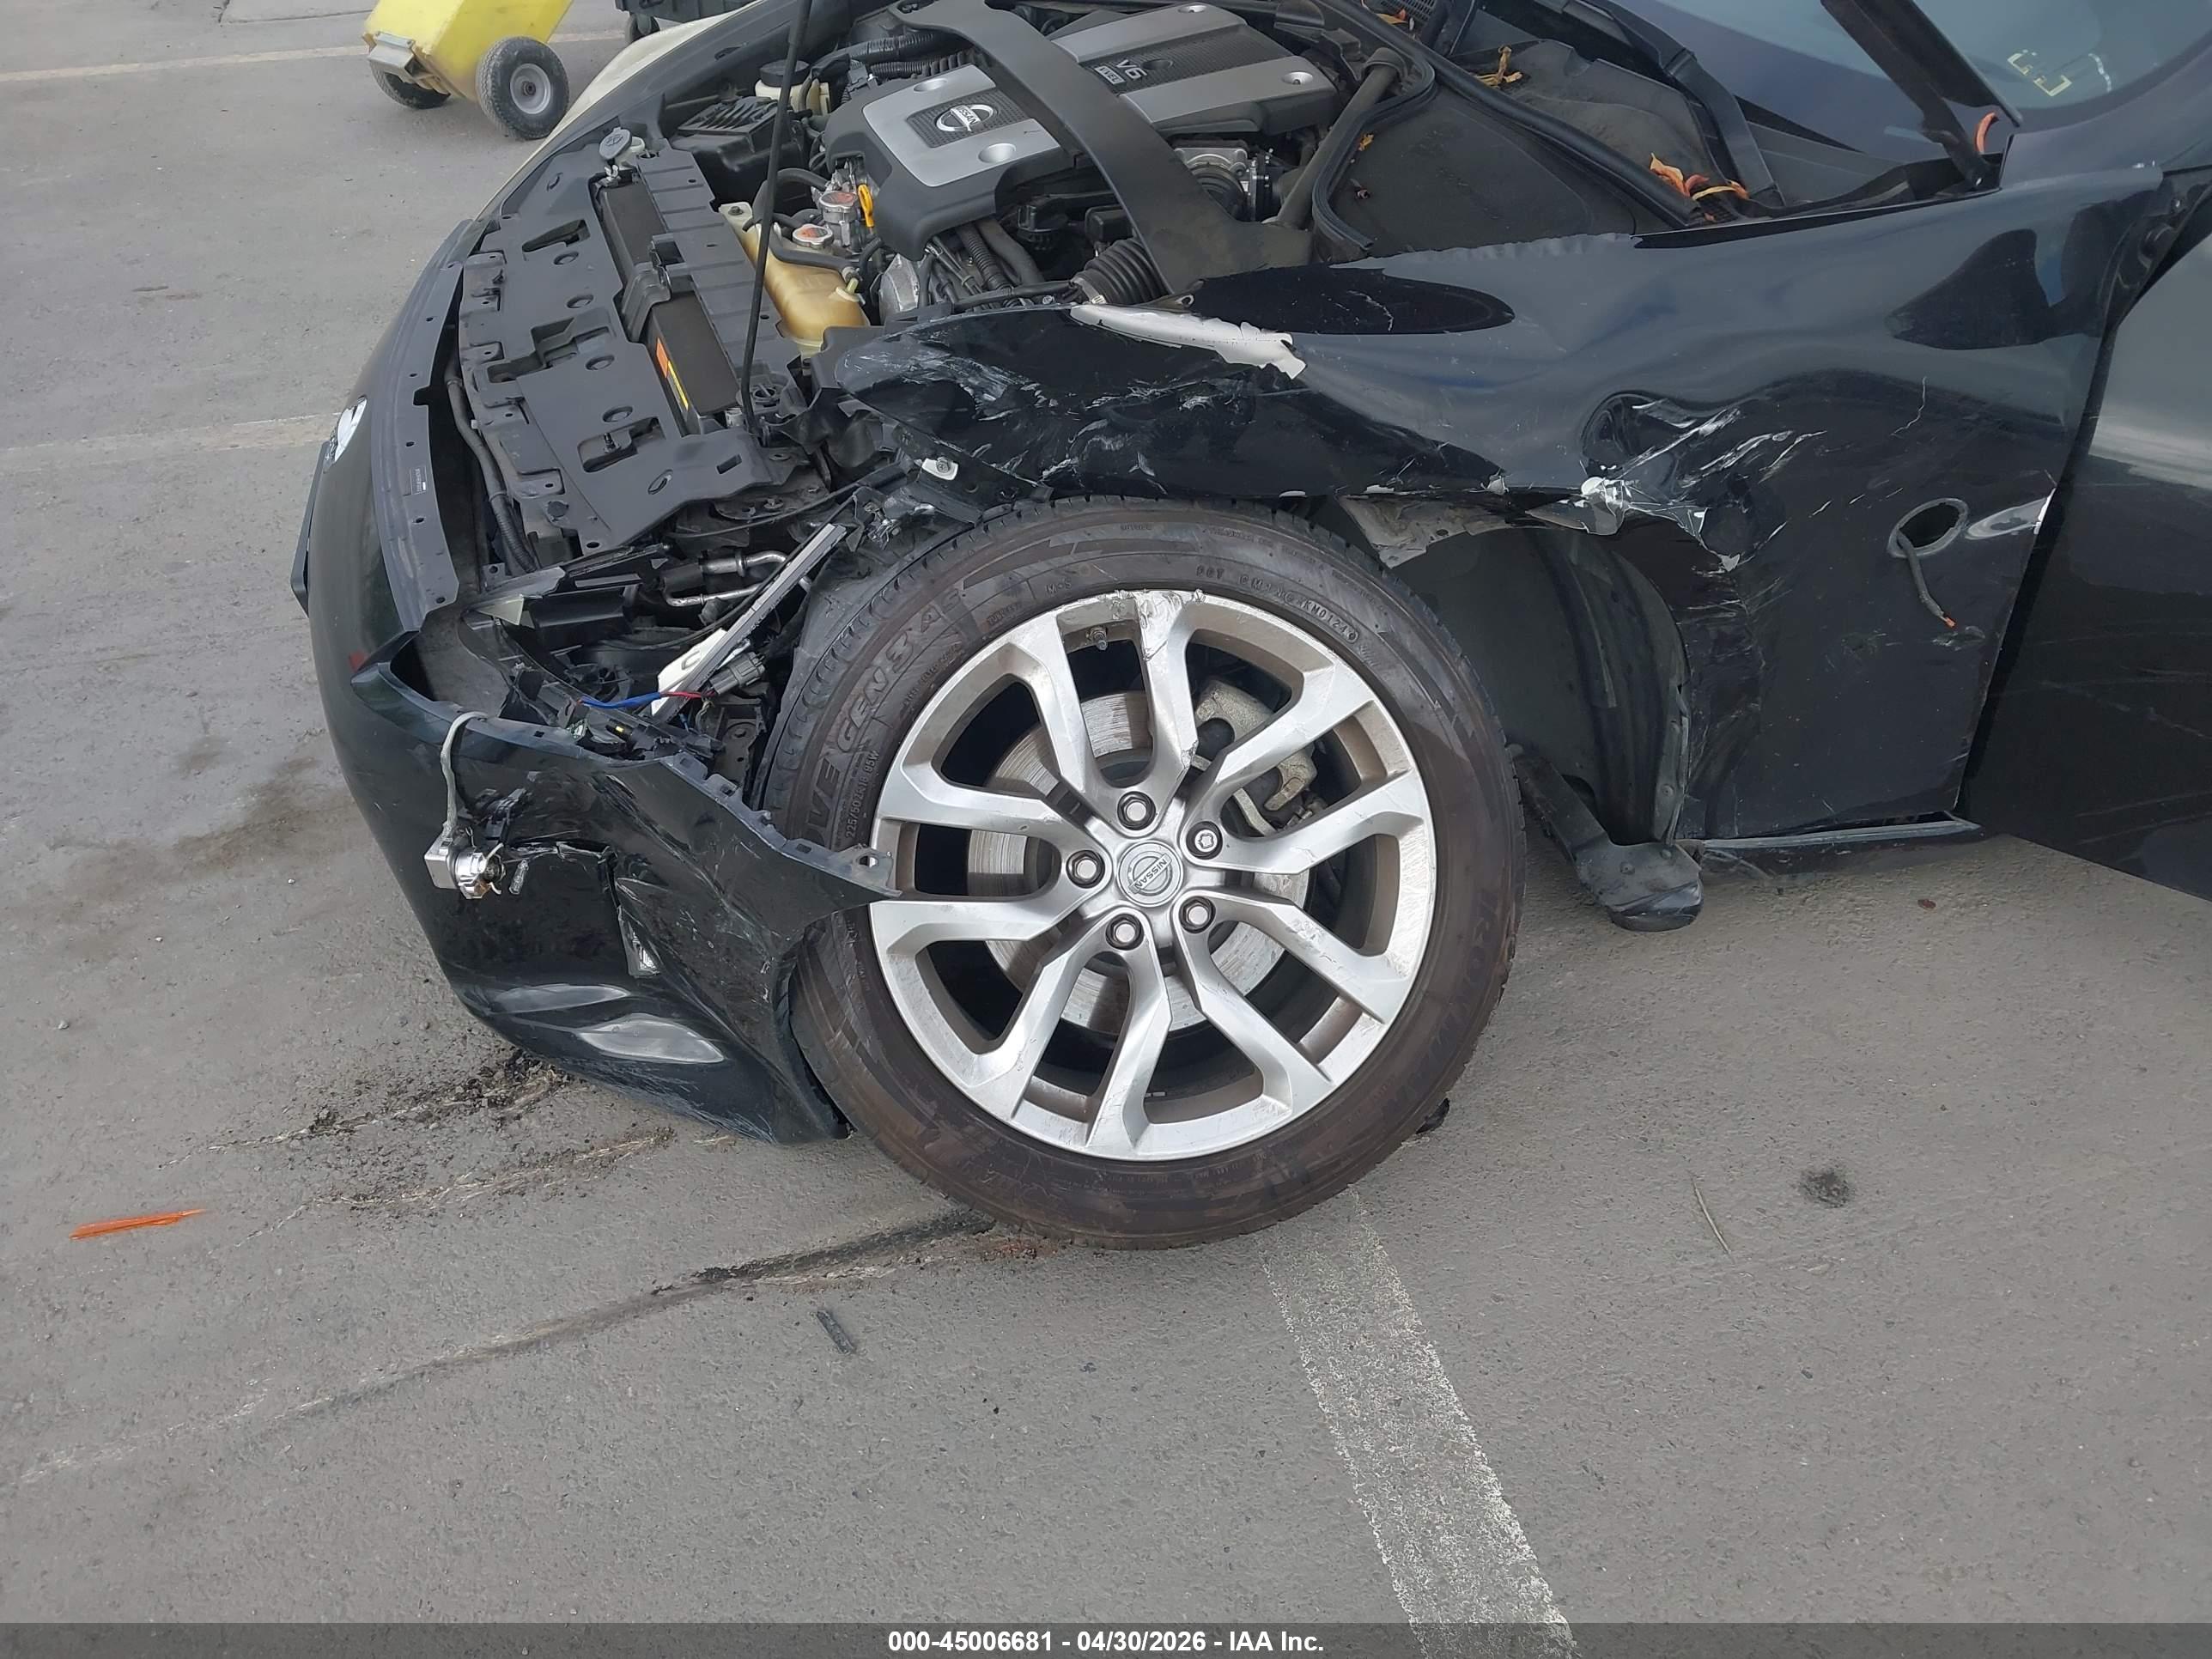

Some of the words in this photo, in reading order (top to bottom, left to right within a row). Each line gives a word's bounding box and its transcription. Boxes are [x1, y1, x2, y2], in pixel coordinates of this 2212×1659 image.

[1115, 59, 1147, 80] V6
[955, 105, 979, 125] NISSAN
[836, 669, 890, 752] GEN
[893, 629, 918, 674] 3
[1133, 858, 1168, 890] NISSAN
